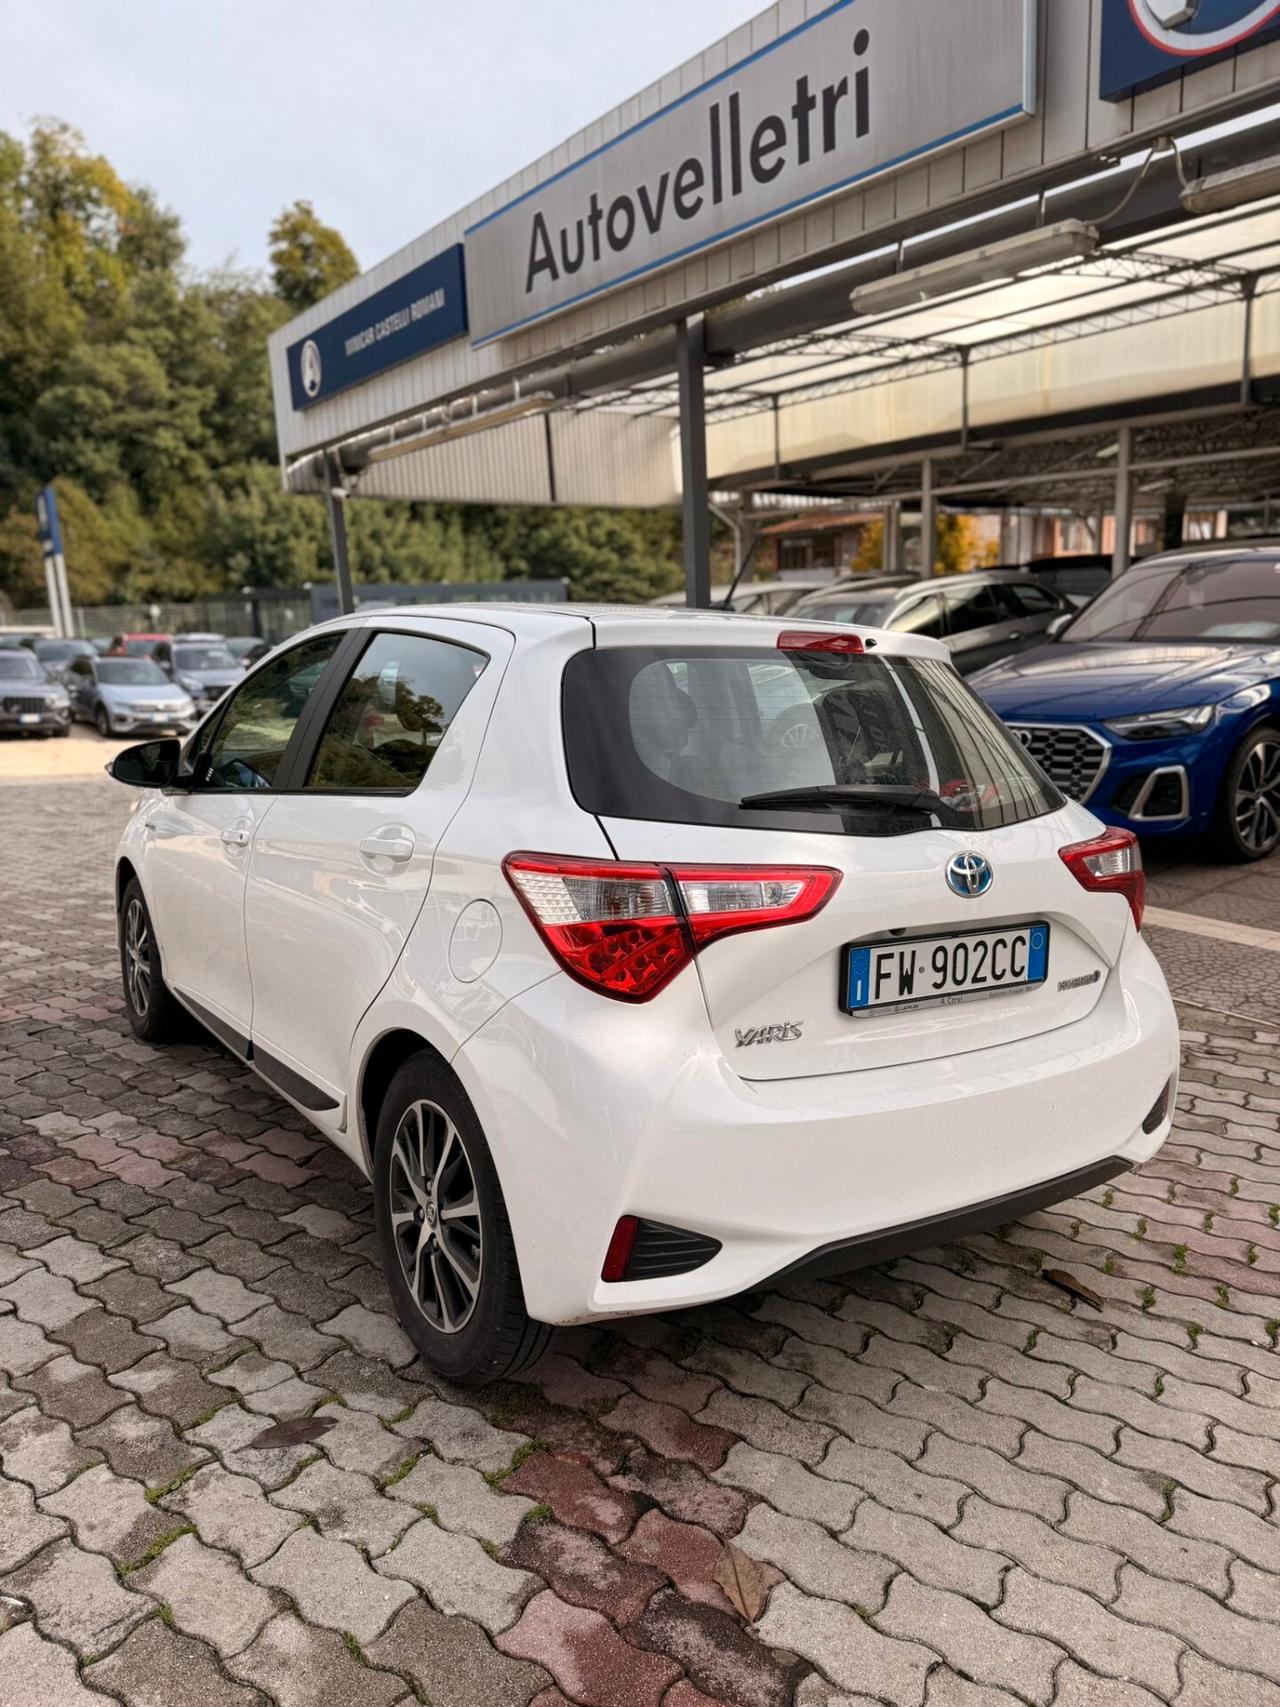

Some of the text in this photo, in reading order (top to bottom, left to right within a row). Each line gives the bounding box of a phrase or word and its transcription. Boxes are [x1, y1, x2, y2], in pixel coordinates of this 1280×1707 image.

[525, 28, 870, 294] Autovelletri
[875, 935, 1027, 1000] FW 902CC
[735, 1020, 804, 1047] YARIS
